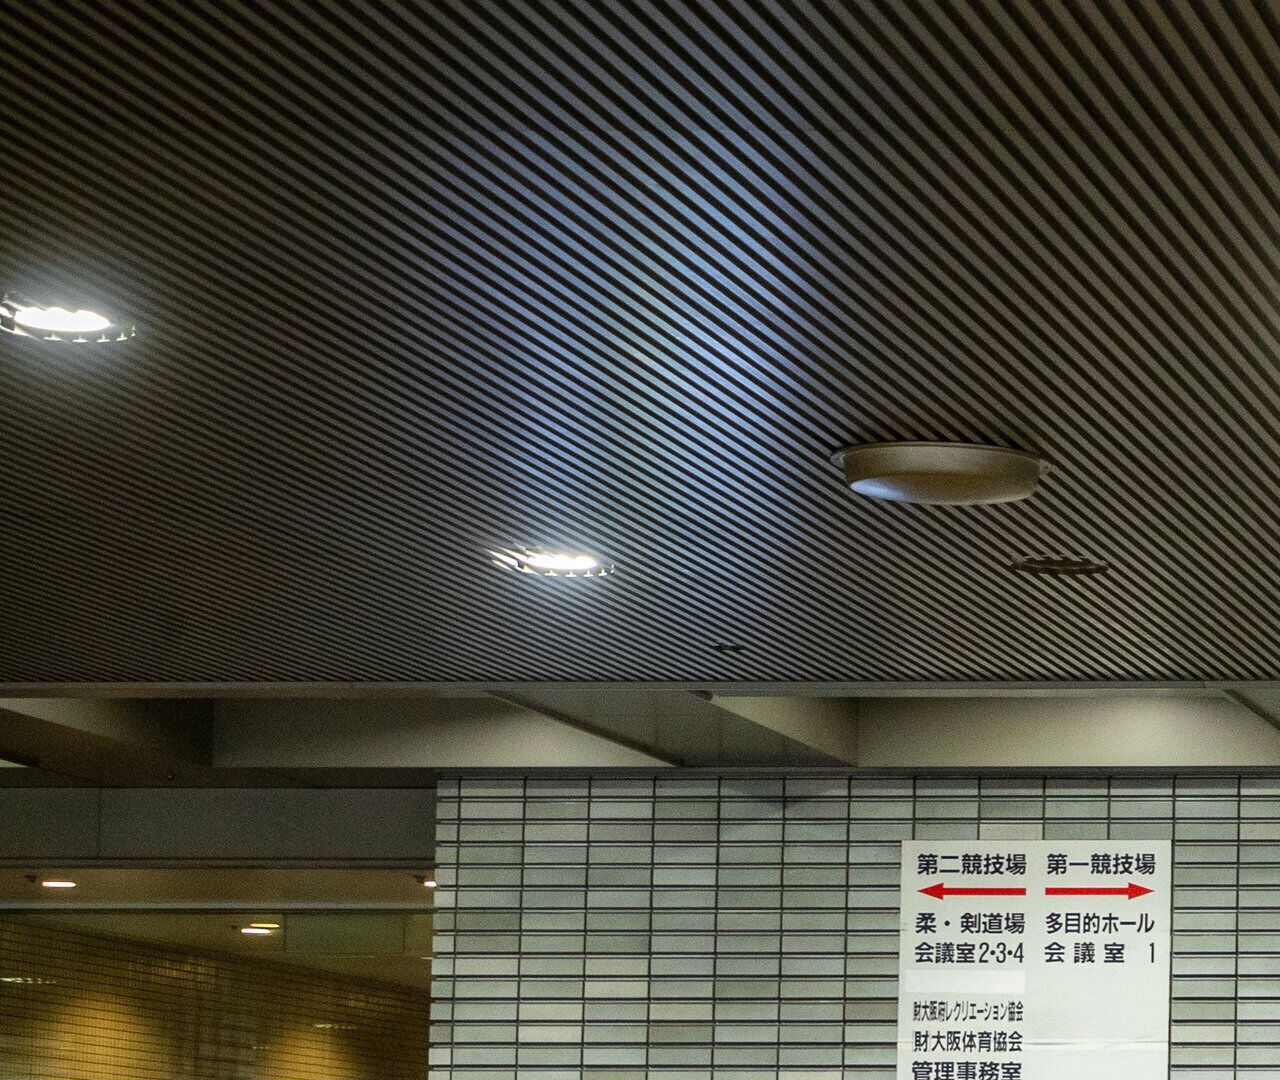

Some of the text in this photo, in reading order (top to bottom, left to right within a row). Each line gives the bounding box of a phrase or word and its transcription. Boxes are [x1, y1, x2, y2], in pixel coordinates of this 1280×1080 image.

[918, 854, 1026, 875] 第二競技場
[1047, 852, 1155, 875] 第一競技場
[916, 913, 1025, 935] 柔・剣道場
[1046, 913, 1154, 935] 多目的ホール
[1150, 943, 1154, 963] 1
